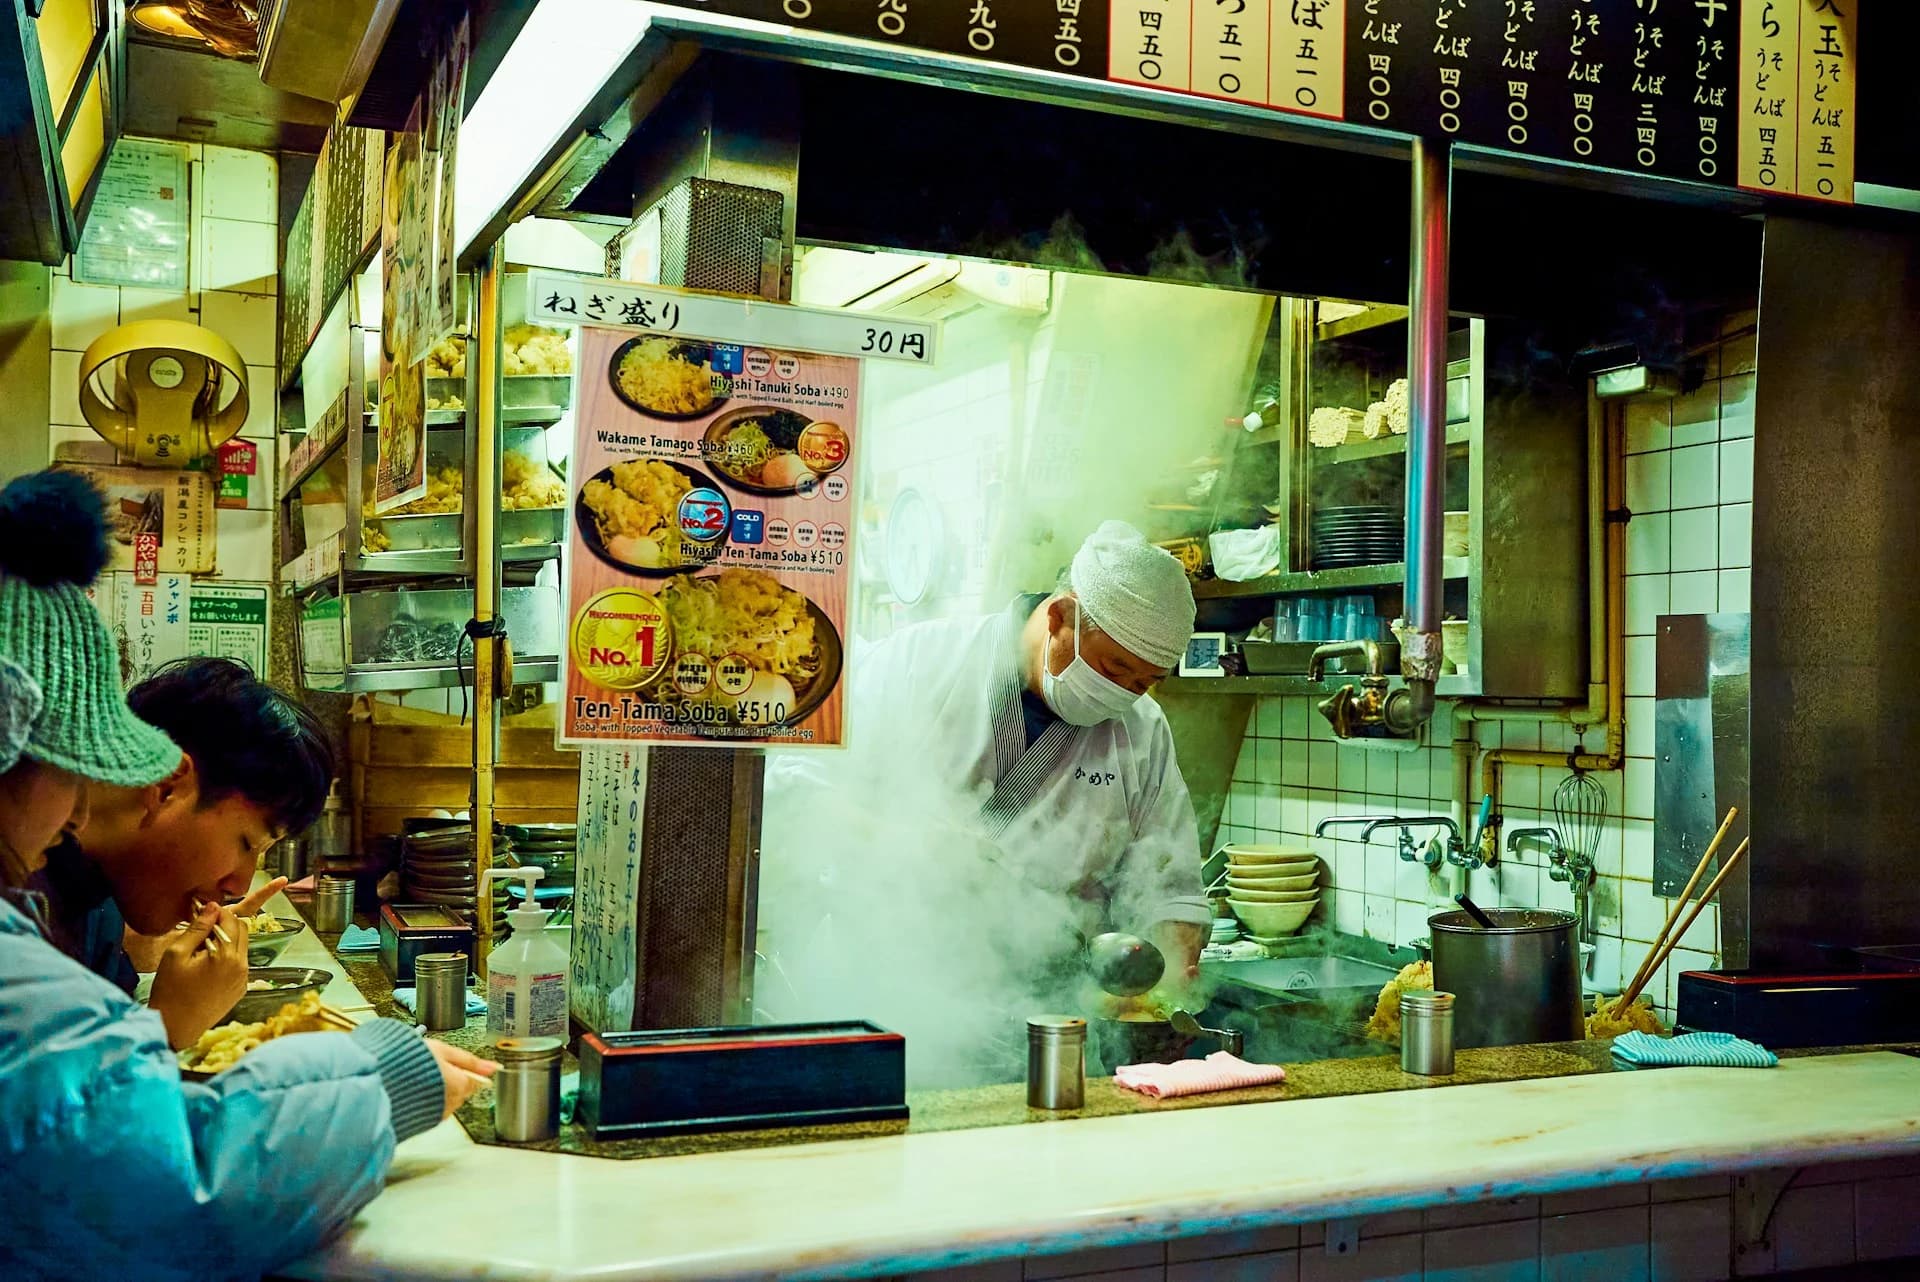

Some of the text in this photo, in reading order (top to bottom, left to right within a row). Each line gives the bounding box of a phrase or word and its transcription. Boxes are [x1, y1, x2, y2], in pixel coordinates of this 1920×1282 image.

[1138, 10, 1163, 80] 四五〇
[1218, 24, 1243, 94] 五一〇
[1295, 39, 1319, 107] 五一〇
[1368, 53, 1392, 121] 四〇〇
[1439, 67, 1462, 133] 四〇〇
[1507, 80, 1529, 144] 四〇〇
[1573, 92, 1594, 156] 四〇〇
[1636, 102, 1658, 167] 三四〇
[1698, 115, 1718, 177] 四〇〇
[1758, 127, 1778, 186] 四五〇
[1816, 135, 1836, 196] 五一〇
[544, 290, 681, 331] ねぎ盛り
[709, 375, 752, 394] Hiyashi
[755, 380, 791, 395] Tanuki
[794, 383, 821, 397] Soba
[597, 430, 647, 447] Wakame
[650, 434, 695, 453] Tamago
[697, 439, 724, 453] Soba
[736, 513, 760, 522] COLD
[680, 542, 843, 566] Hiyashi Ten-Tama Soba ¥510
[166, 577, 180, 625] ジャンボ
[589, 626, 656, 667] No.1
[573, 696, 787, 723] Ten-Tama Soba ¥510
[600, 722, 620, 732] with
[622, 722, 653, 734] Topped
[798, 728, 814, 739] egg
[1074, 765, 1115, 786] かめや
